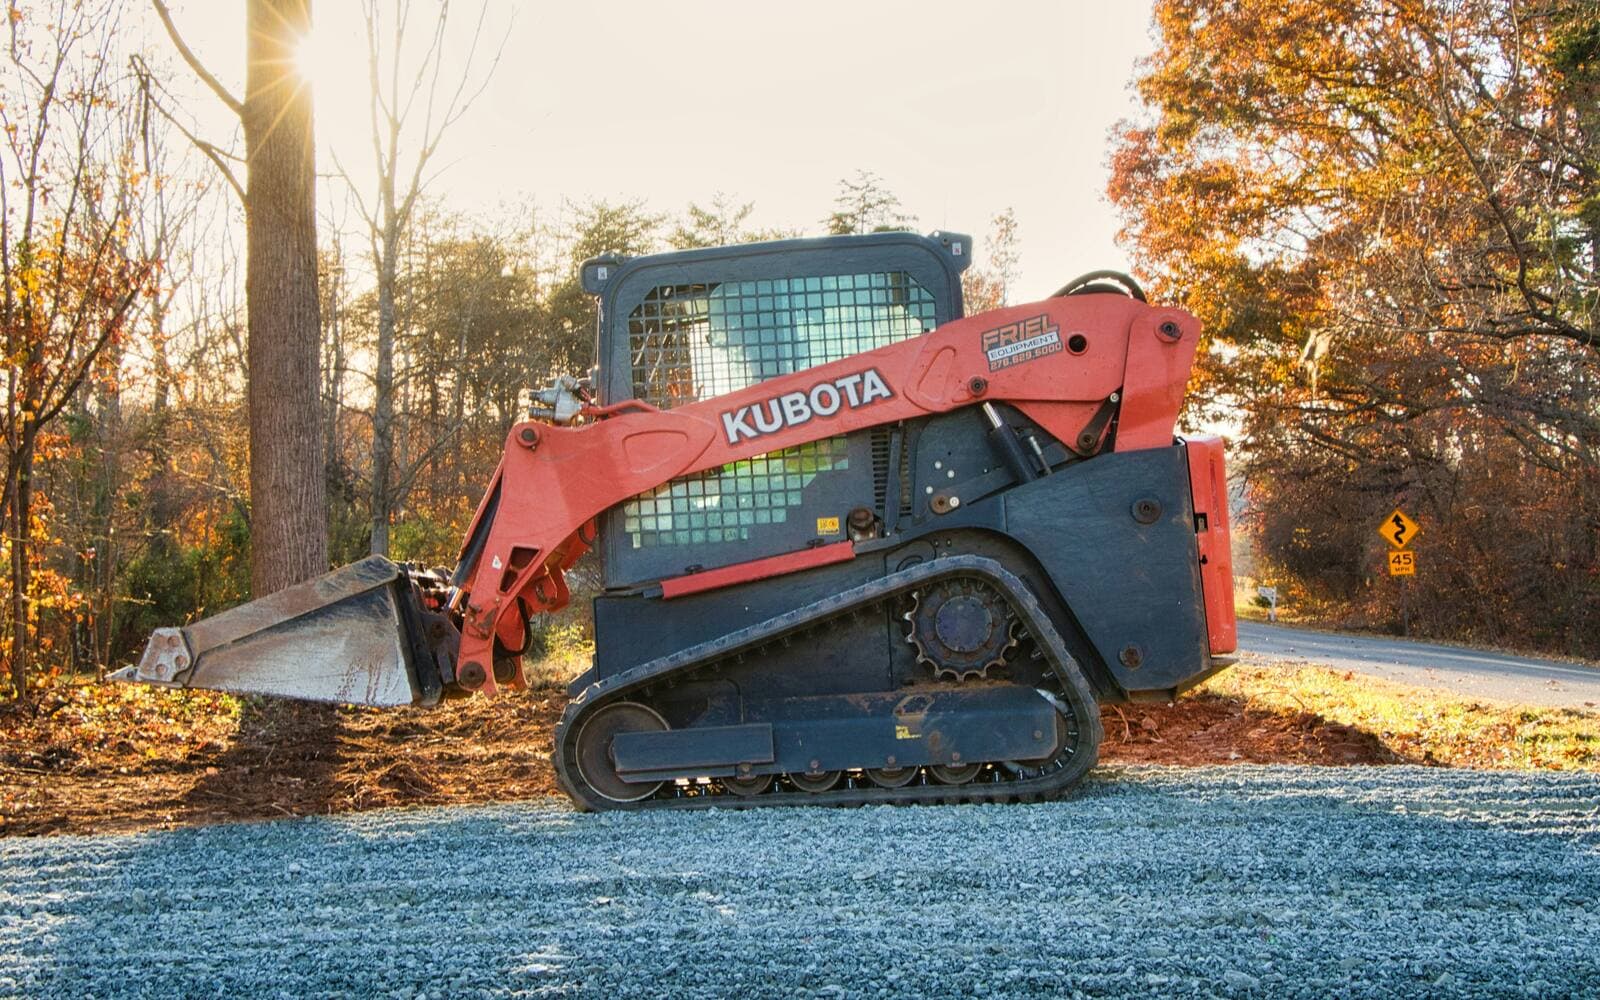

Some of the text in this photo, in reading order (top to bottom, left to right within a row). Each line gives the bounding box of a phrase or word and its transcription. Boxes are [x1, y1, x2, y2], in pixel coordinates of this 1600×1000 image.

[982, 315, 1058, 351] FRIEL
[990, 334, 1056, 359] EQUIPMENT
[721, 369, 892, 444] KUBOTA
[1391, 554, 1412, 565] 45
